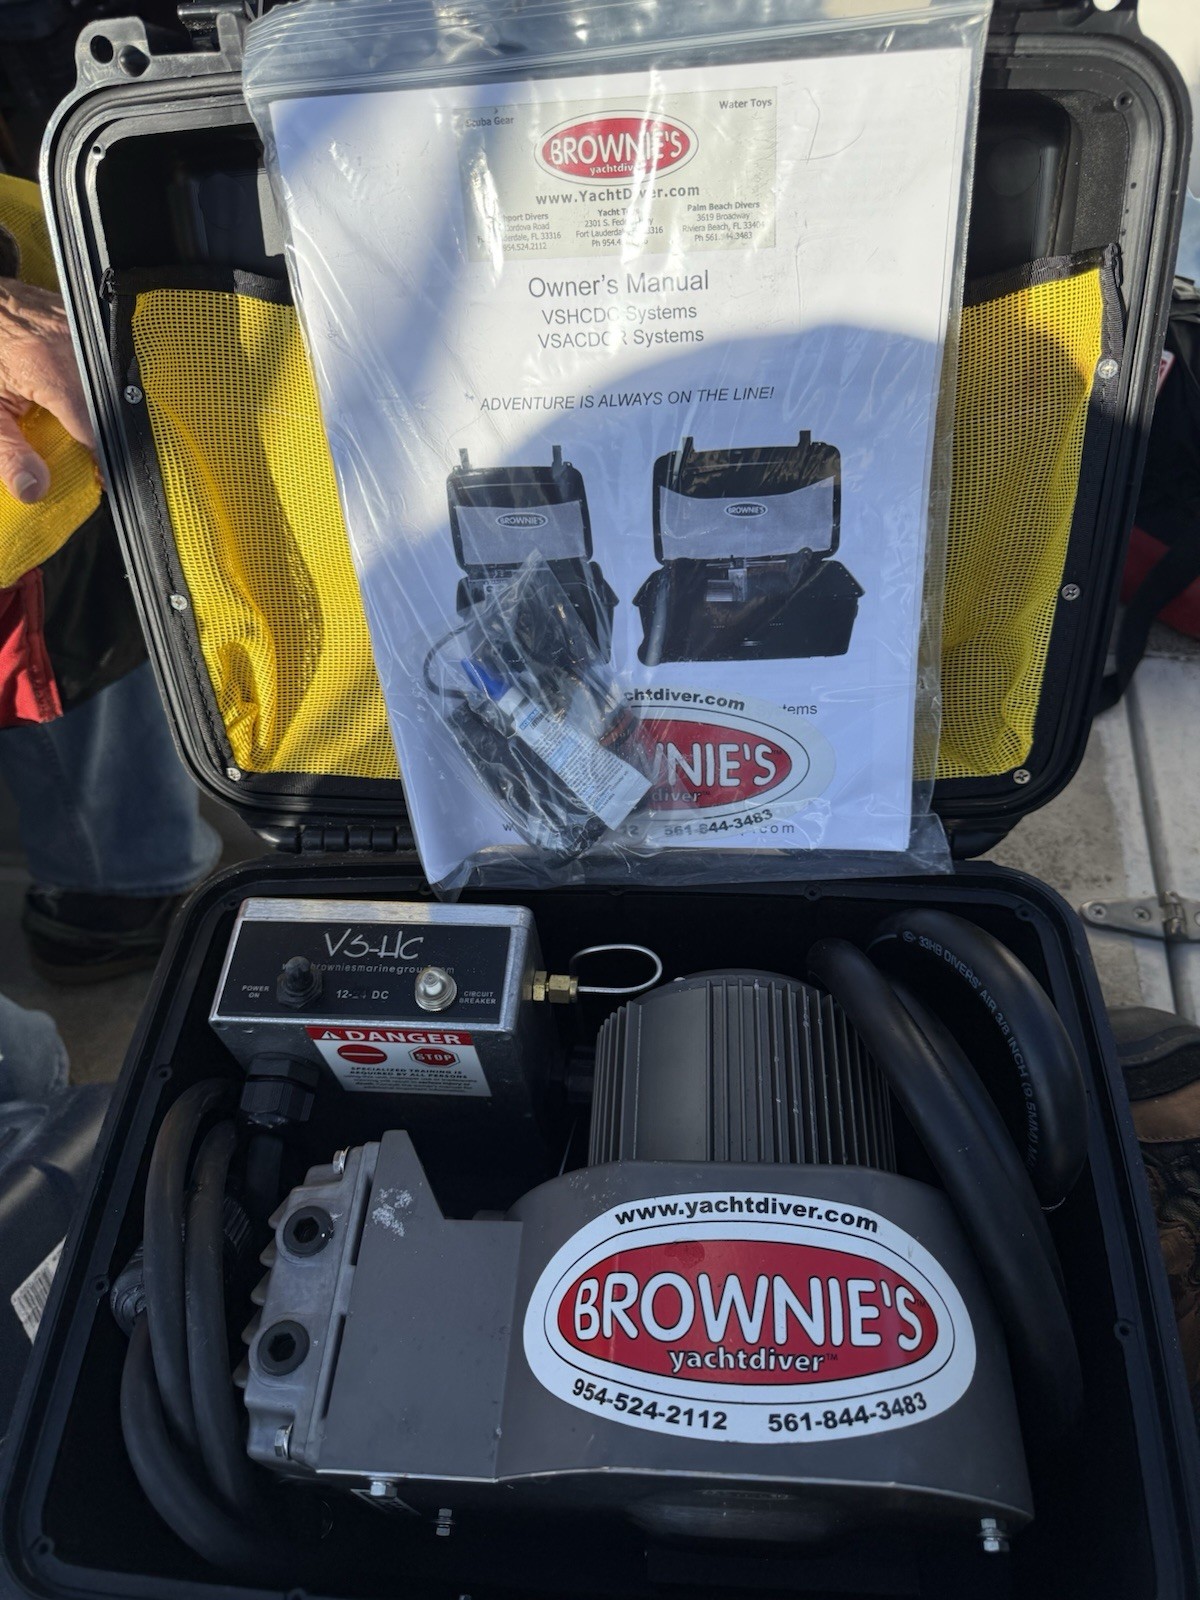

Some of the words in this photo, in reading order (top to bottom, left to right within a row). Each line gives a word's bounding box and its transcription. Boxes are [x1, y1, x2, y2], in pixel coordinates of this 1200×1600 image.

[719, 100, 748, 110] Water
[750, 98, 773, 109] Toys
[465, 117, 492, 128] Scuba
[494, 116, 515, 126] Gear
[535, 185, 700, 205] www.YachtDver.com
[687, 203, 707, 212] Palm
[708, 201, 733, 211] Beach
[735, 200, 760, 209] Divers
[525, 213, 549, 221] Divers
[597, 208, 620, 218] Yacht
[716, 212, 751, 221] Broadway
[533, 221, 550, 230] Road
[584, 220, 601, 228] 2301
[707, 222, 731, 232] Beach,
[732, 221, 742, 230] FL
[531, 232, 541, 240] FL
[576, 230, 589, 239] Fort
[694, 234, 704, 242] Ph
[592, 240, 601, 248] Ph
[528, 274, 619, 298] Owner's
[626, 270, 709, 294] Manual
[625, 304, 698, 325] Systems
[632, 327, 705, 348] Systems
[480, 395, 575, 411] ADVENTURE
[579, 394, 594, 408] IS
[597, 391, 664, 408] ALWAYS
[667, 390, 693, 405] ON
[697, 388, 729, 402] THE
[733, 386, 775, 400] LINE!
[499, 516, 545, 526] BROWNIE'S
[241, 984, 271, 992] POWER
[248, 991, 260, 999] ON
[371, 989, 390, 1000] DC
[463, 990, 495, 998] CIRCUIT
[458, 997, 497, 1005] BREAKER
[345, 1029, 462, 1046] DANGER
[979, 988, 998, 1014] AIR
[994, 1011, 1012, 1037] 3/8
[1007, 1036, 1031, 1079] INCH
[414, 1052, 452, 1063] STOP
[613, 1194, 880, 1234] www.yachtdiver.com
[571, 1377, 729, 1431] 954-524-2112
[766, 1391, 928, 1434] 561-844-3483
